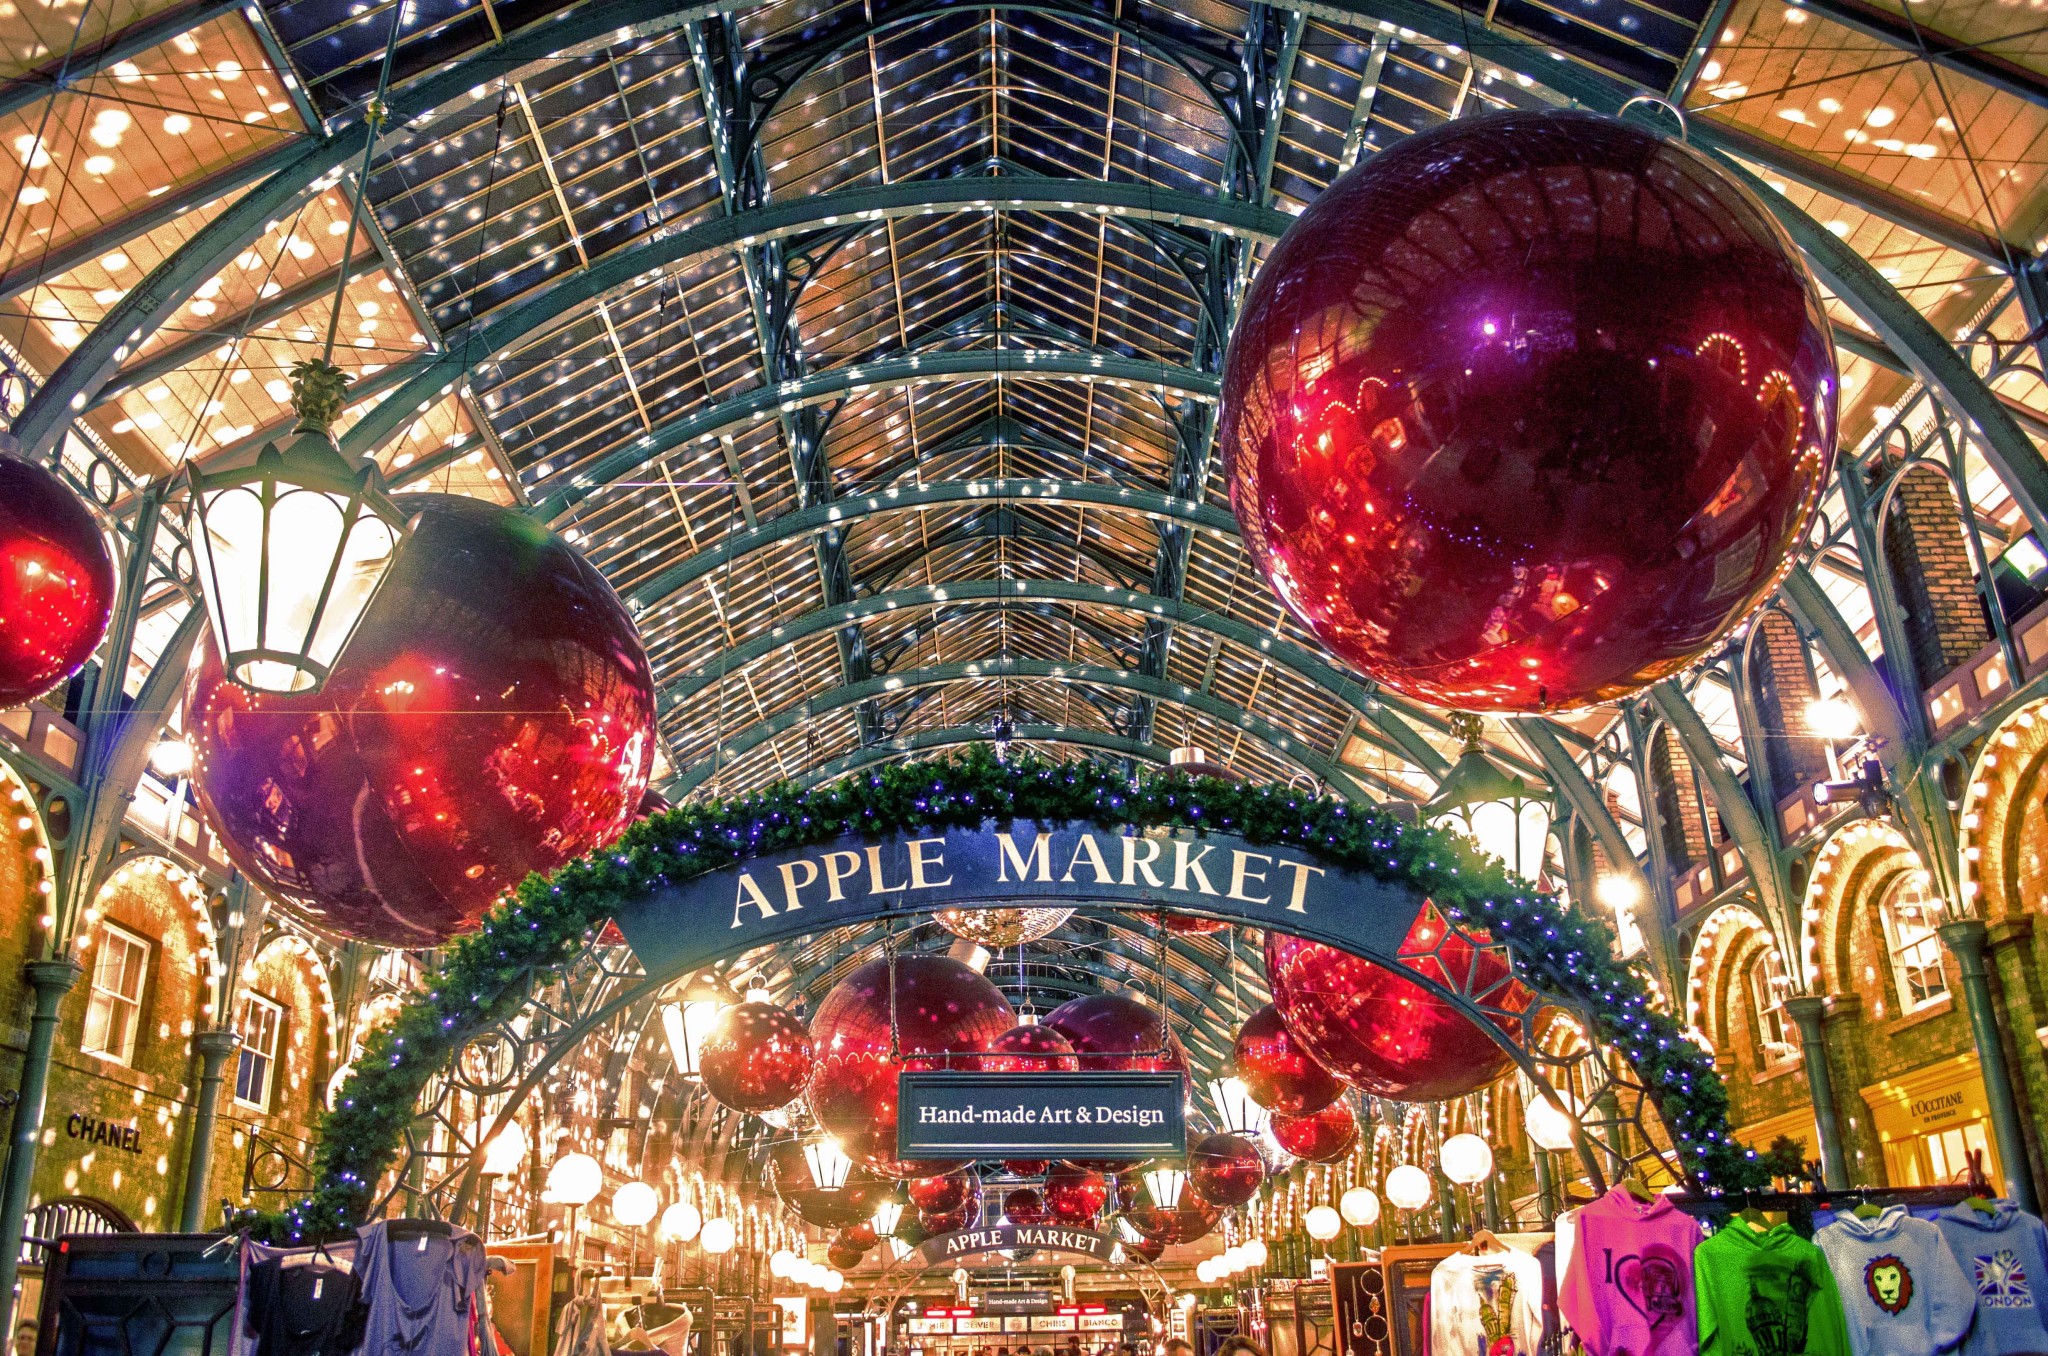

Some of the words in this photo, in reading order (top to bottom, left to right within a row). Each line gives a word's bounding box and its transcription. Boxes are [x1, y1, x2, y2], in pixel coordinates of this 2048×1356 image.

[730, 837, 953, 929] APPLE
[993, 832, 1326, 914] MARKET
[919, 1105, 1036, 1124] Hand-made
[1039, 1106, 1072, 1124] Art
[1076, 1106, 1091, 1124] &
[1096, 1105, 1164, 1127] Design
[1911, 1091, 1964, 1117] L'OCCITANE
[67, 1112, 143, 1155] CHANEL
[946, 1230, 1003, 1254] APPLE
[1017, 1229, 1101, 1253] MARKET
[1602, 1248, 1613, 1284] I
[917, 1321, 945, 1330] JMIE
[1039, 1319, 1067, 1328] CHRIS
[1083, 1318, 1118, 1327] BIANCO
